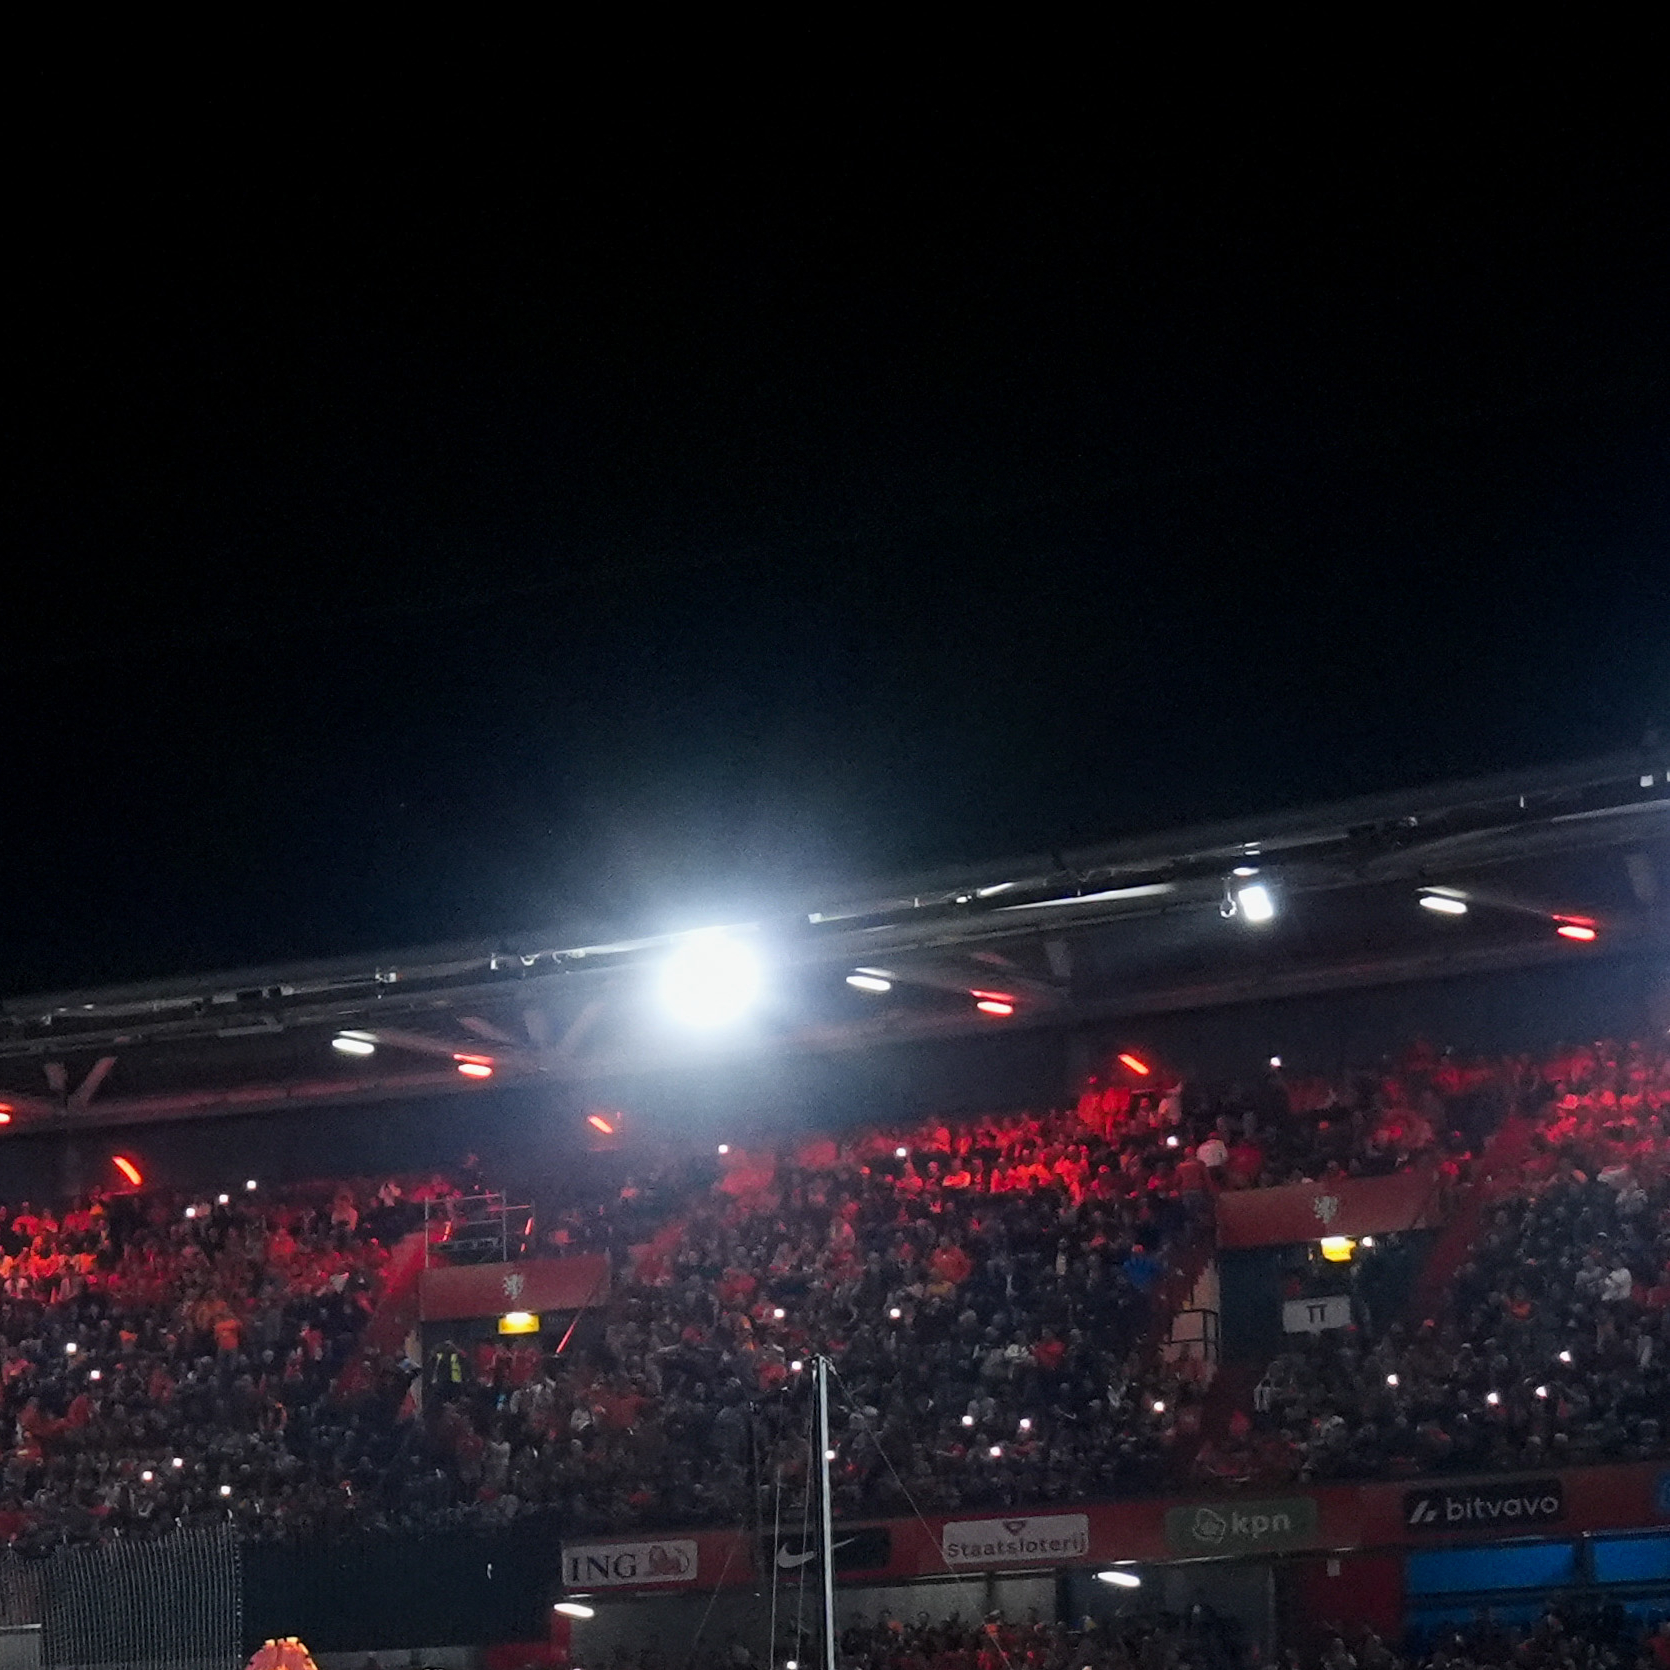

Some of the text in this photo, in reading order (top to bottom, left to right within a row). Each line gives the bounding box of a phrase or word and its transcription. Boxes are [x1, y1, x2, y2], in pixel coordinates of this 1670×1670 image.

[1307, 1304, 1327, 1323] TT
[1445, 1494, 1559, 1522] bitvavo
[1231, 1509, 1290, 1537] kpn
[947, 1530, 1090, 1560] Staatsloterij
[571, 1551, 637, 1581] ING
